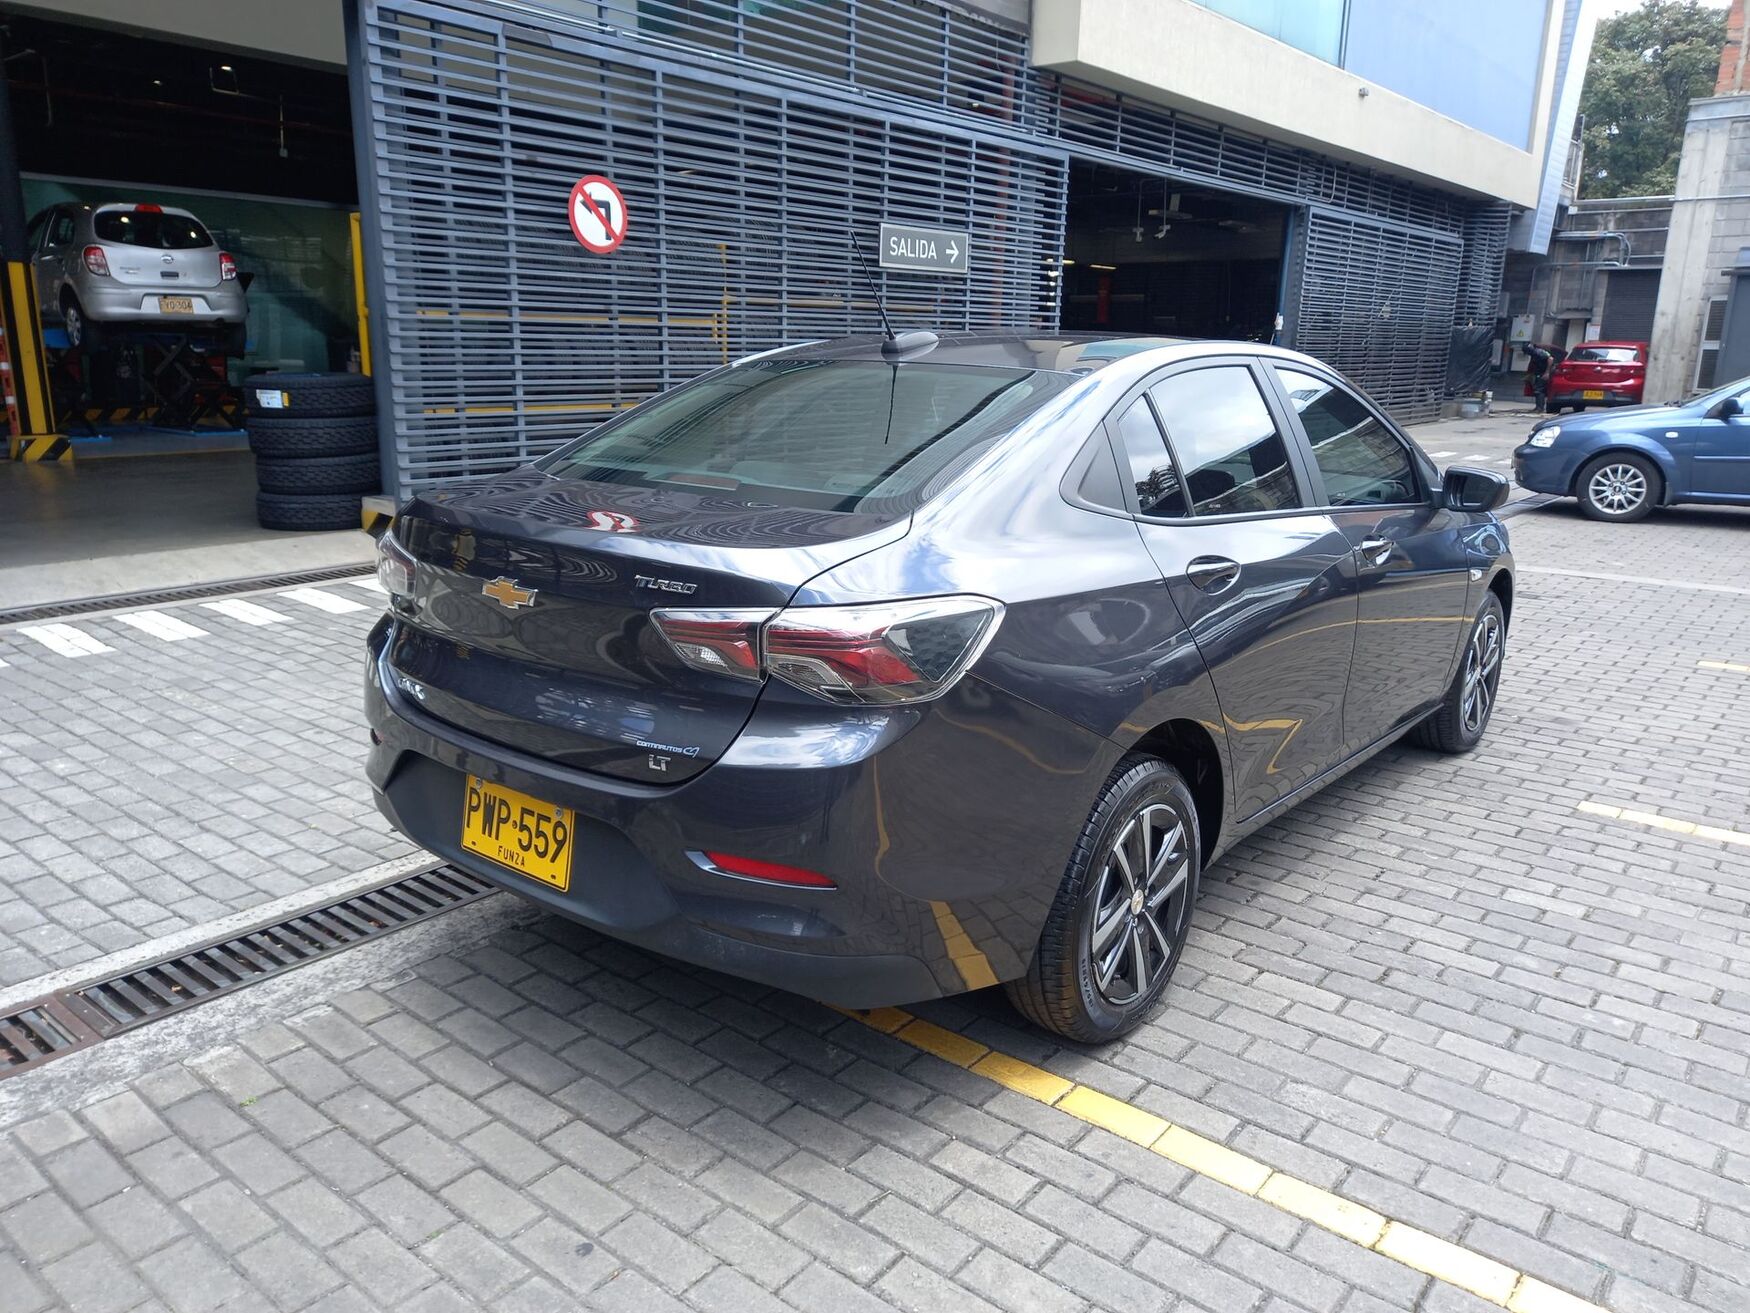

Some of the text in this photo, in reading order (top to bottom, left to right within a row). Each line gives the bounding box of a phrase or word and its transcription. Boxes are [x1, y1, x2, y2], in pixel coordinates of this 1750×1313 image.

[889, 236, 937, 258] SALIDA
[634, 574, 698, 595] TURBO
[648, 754, 671, 772] LT
[497, 845, 526, 867] FUNZA
